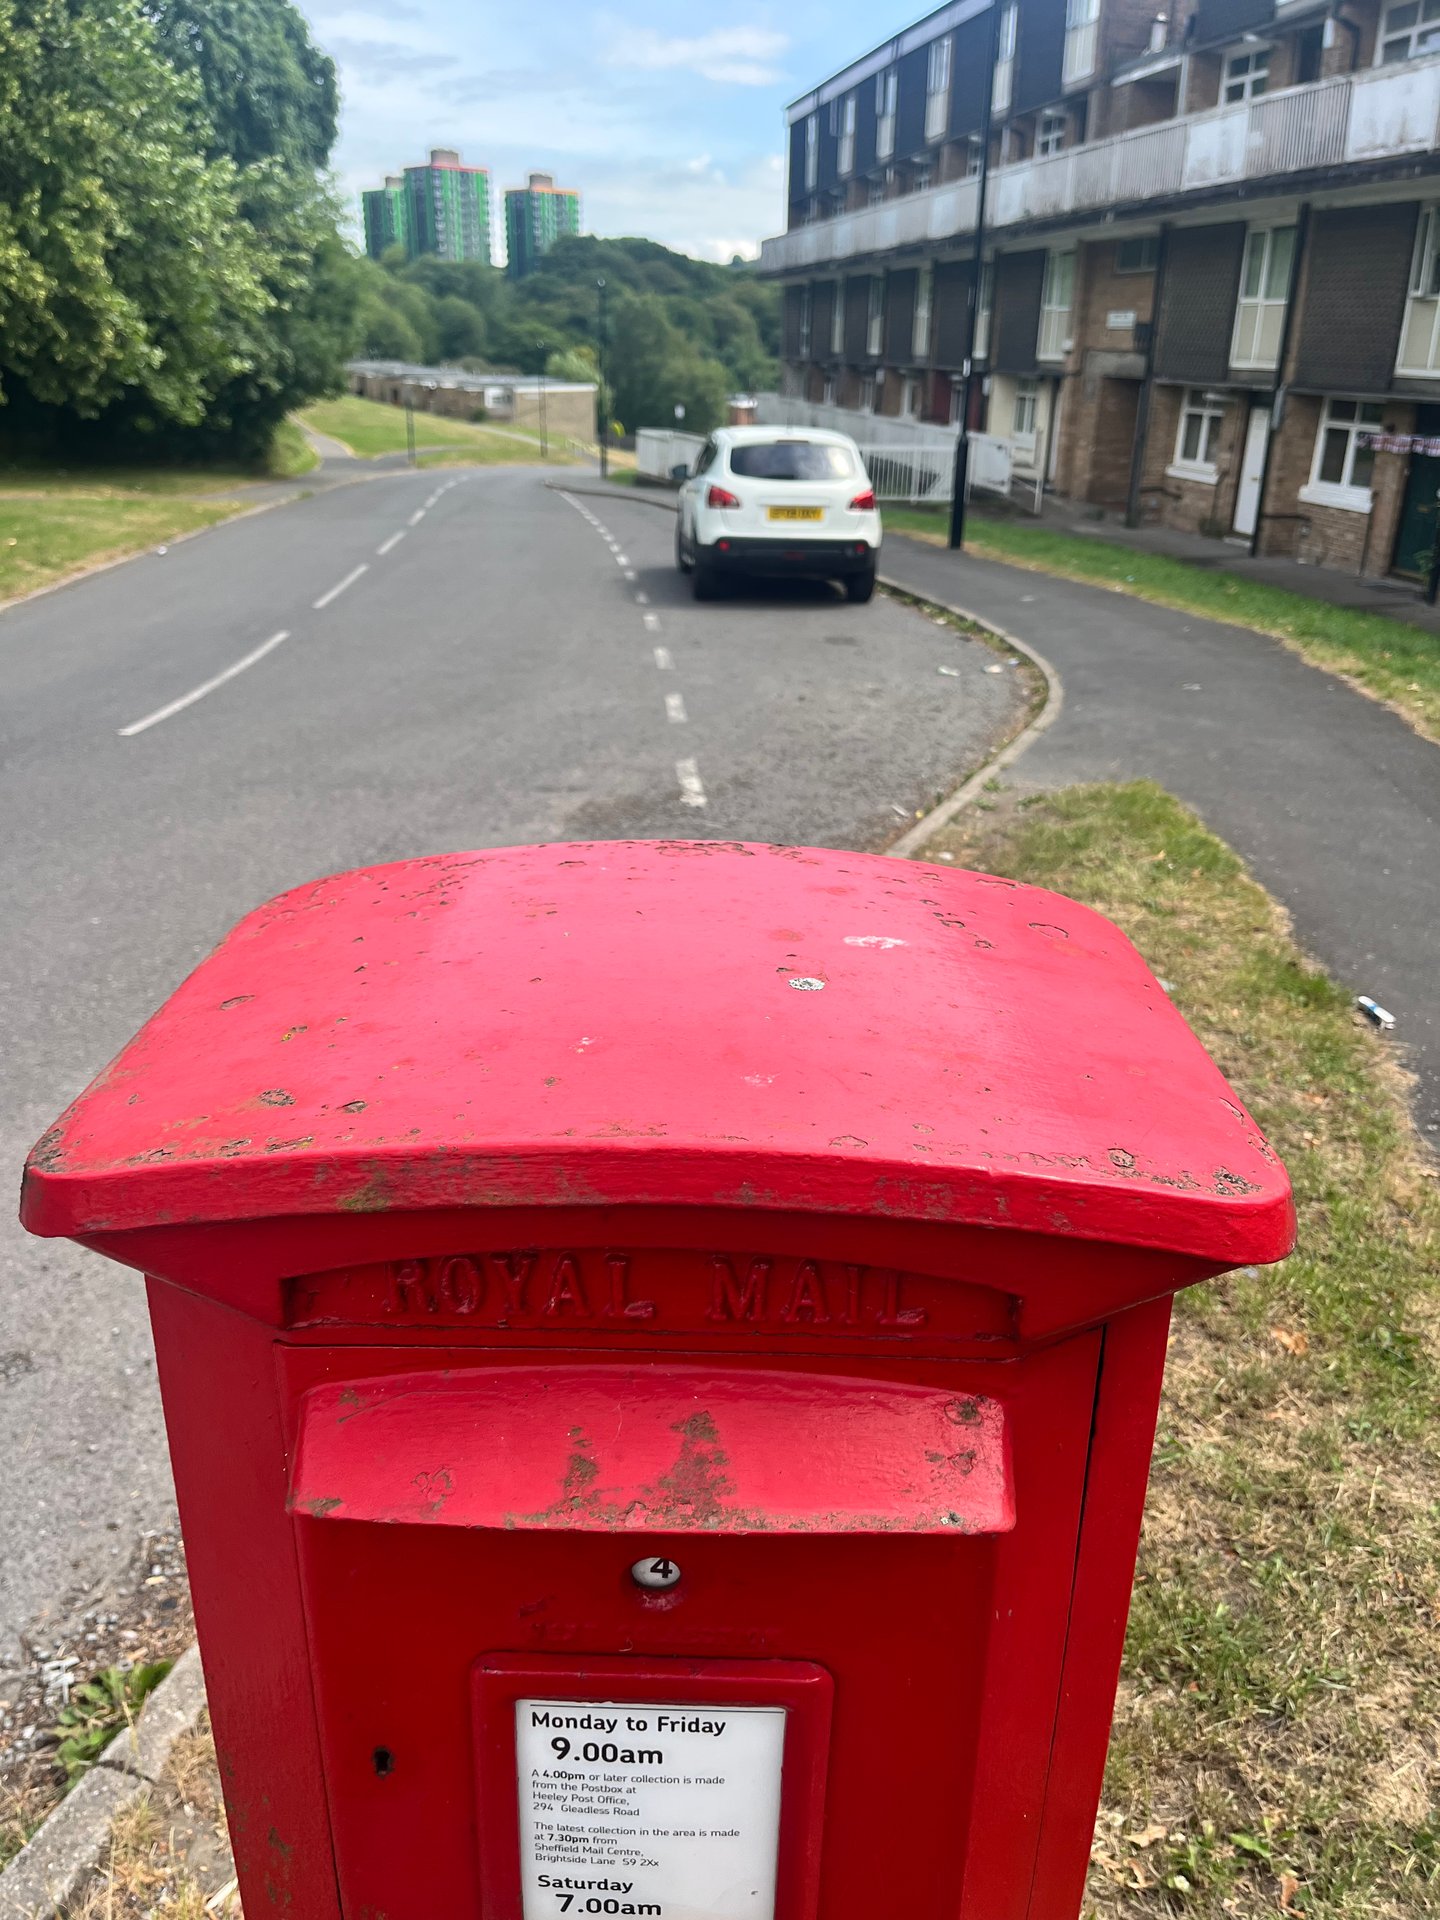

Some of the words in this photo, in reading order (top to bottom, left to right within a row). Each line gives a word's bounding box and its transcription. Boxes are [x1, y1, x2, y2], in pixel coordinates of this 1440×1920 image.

[385, 1253, 656, 1317] ROYAL
[706, 1256, 928, 1327] MAIL
[650, 1558, 673, 1579] 4
[531, 1711, 618, 1733] Monday
[626, 1717, 648, 1731] to
[657, 1716, 726, 1736] Friday
[551, 1736, 663, 1764] 9.00am
[531, 1769, 540, 1777] A
[542, 1770, 585, 1781] 4.00pm
[588, 1773, 600, 1781] or
[603, 1773, 628, 1783] later
[630, 1774, 680, 1784] collection
[683, 1775, 692, 1784] is
[695, 1775, 725, 1785] made
[532, 1780, 557, 1790] from
[560, 1782, 578, 1791] the
[581, 1783, 623, 1793] Postbox
[625, 1786, 637, 1794] at
[532, 1792, 568, 1802] Heeley
[571, 1793, 594, 1803] Post
[597, 1795, 630, 1805] Office,
[532, 1802, 554, 1811] 294
[560, 1804, 610, 1815] Gleadless
[613, 1806, 640, 1816] Road
[534, 1821, 553, 1831] The
[556, 1823, 585, 1833] latest
[588, 1825, 636, 1835] collection
[639, 1827, 649, 1836] in
[652, 1828, 670, 1836] the
[672, 1829, 696, 1837] area
[699, 1828, 707, 1837] is
[710, 1829, 740, 1837] made
[533, 1833, 544, 1841] at
[547, 1834, 589, 1845] 7.30pm
[592, 1835, 618, 1845] from
[534, 1843, 579, 1853] Sheffield
[582, 1845, 604, 1855] Mail
[607, 1847, 644, 1857] Centre,
[535, 1853, 587, 1864] Brightside
[590, 1856, 616, 1865] Lane
[537, 1874, 633, 1893] Saturday
[555, 1893, 662, 1916] 7.00am
